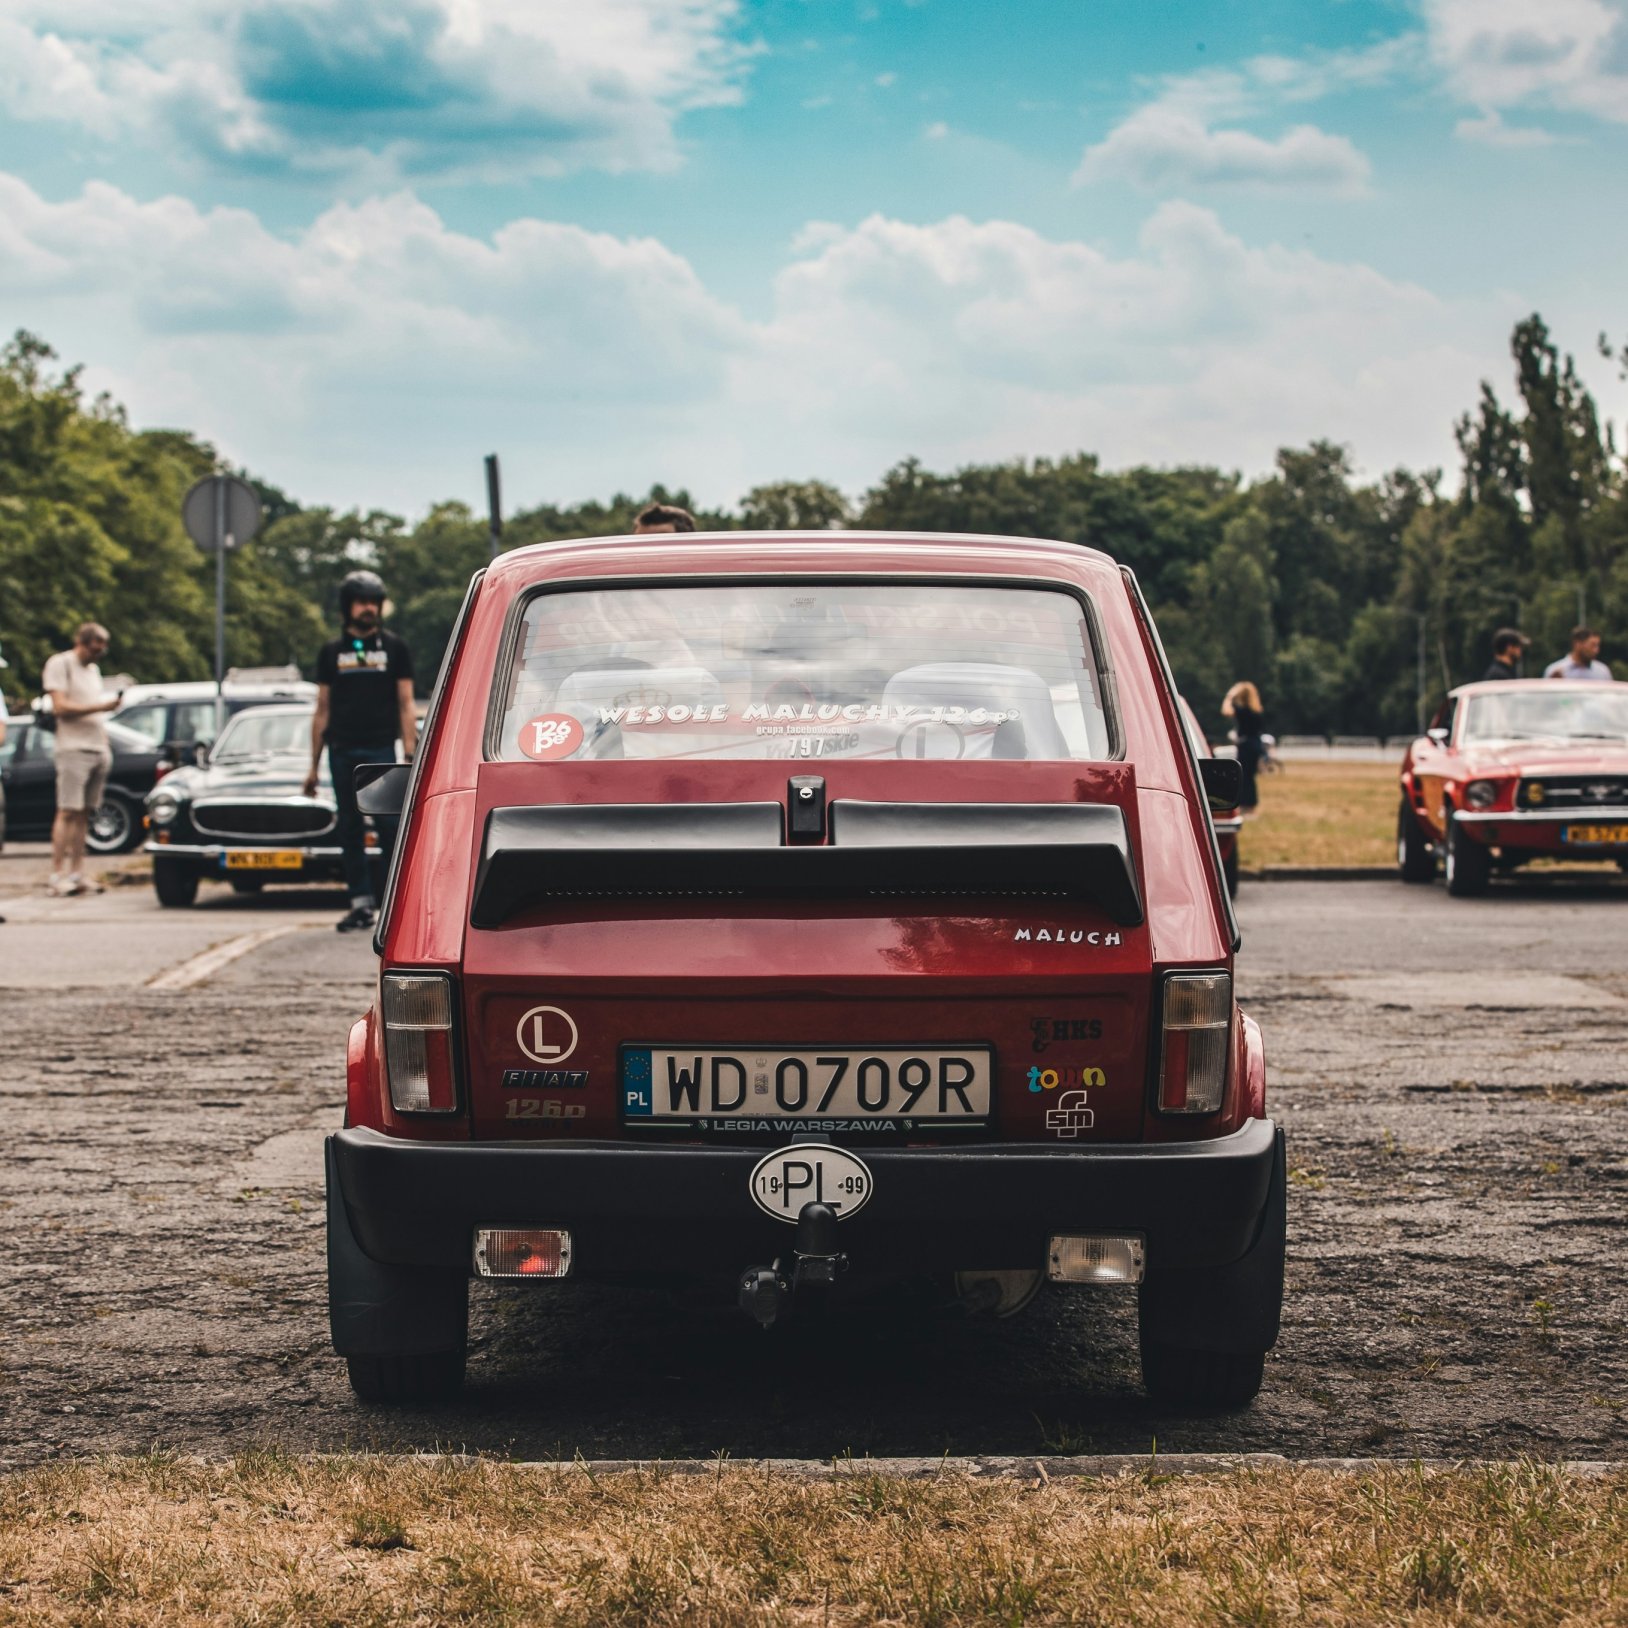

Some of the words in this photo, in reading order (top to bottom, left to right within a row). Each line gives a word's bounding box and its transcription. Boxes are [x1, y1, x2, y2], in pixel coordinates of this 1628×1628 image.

[740, 703, 922, 727] MALUCHY
[756, 725, 784, 736] grupa
[786, 725, 850, 736] facebook.com
[789, 736, 825, 758] 797
[1014, 928, 1121, 946] MALUCH
[533, 1015, 561, 1054] L
[508, 1072, 583, 1087] FIAT
[667, 1055, 747, 1112] WD
[775, 1056, 976, 1113] 0709R
[1026, 1065, 1107, 1093] town
[627, 1091, 648, 1106] PL
[713, 1120, 772, 1132] LEGIA
[773, 1120, 896, 1132] WARSZAWA
[760, 1176, 779, 1194] 19
[782, 1161, 842, 1208] PL
[845, 1176, 864, 1194] 99
